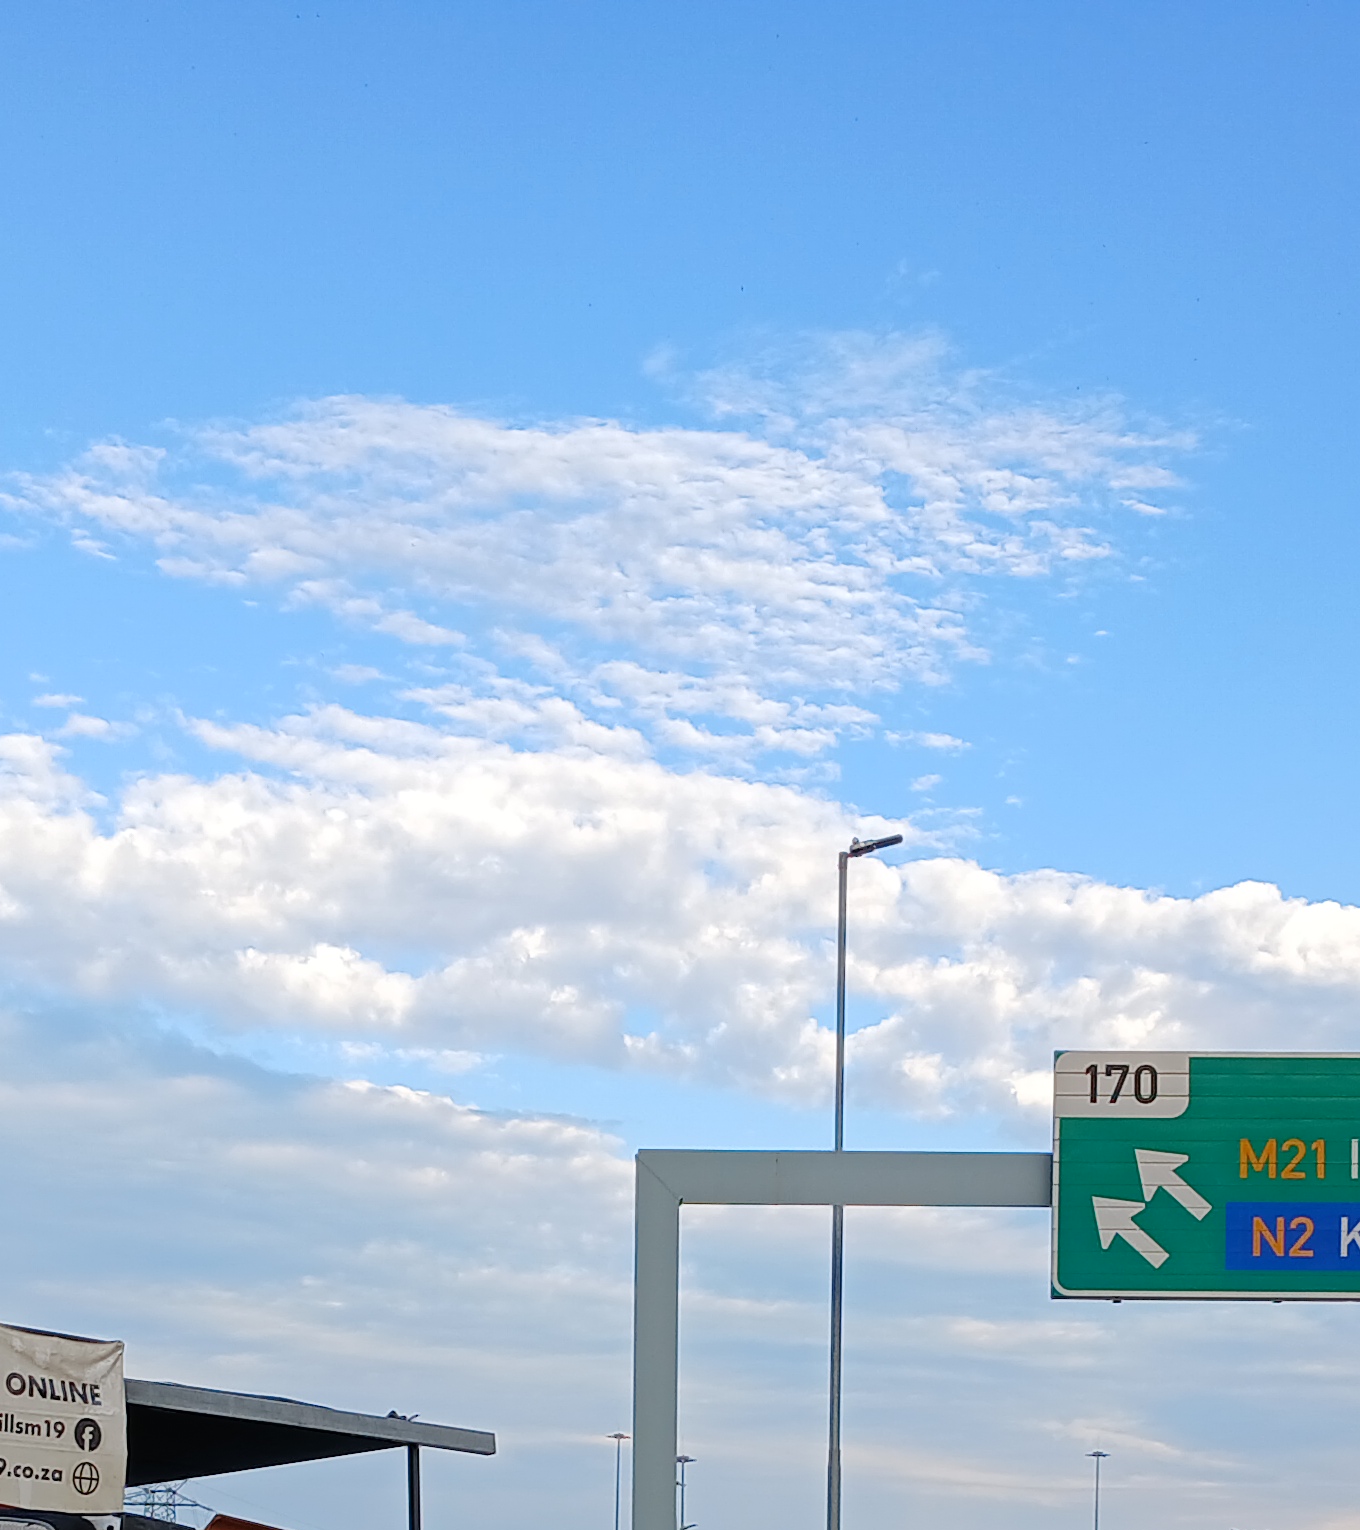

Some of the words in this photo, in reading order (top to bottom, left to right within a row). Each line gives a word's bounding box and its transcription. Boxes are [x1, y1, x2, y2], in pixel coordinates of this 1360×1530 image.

[1085, 1065, 1158, 1104] 170
[1240, 1139, 1325, 1179] M21
[1253, 1217, 1314, 1257] N2
[6, 1372, 102, 1406] ONLINE
